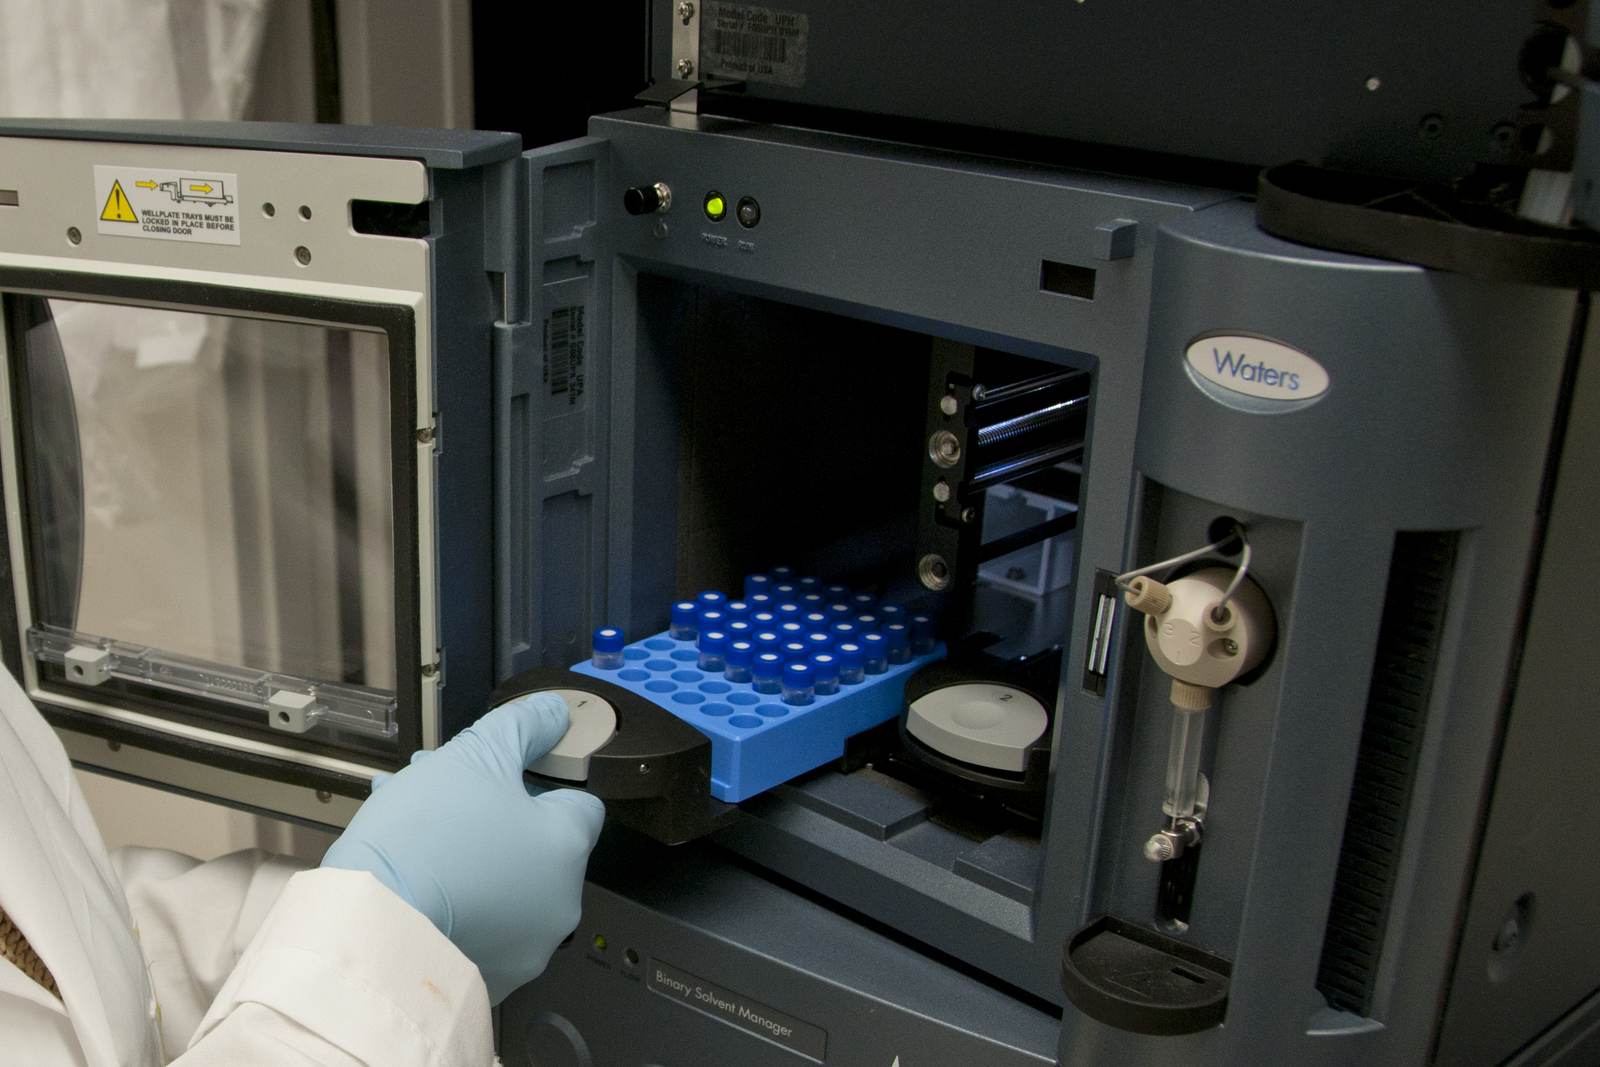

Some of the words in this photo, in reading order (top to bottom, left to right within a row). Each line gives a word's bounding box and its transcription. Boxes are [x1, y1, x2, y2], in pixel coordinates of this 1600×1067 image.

[746, 10, 768, 24] Code
[142, 210, 180, 219] WELLPLATE
[182, 212, 203, 220] TRAYS
[204, 214, 223, 222] MUST
[224, 215, 234, 223] BE
[141, 218, 170, 226] LOCKED
[181, 221, 204, 229] PLACE
[206, 222, 235, 231] BEFORE
[142, 225, 171, 234] CLOSING
[172, 227, 192, 235] DOOR
[1213, 347, 1300, 391] Waters
[1000, 694, 1013, 702] 2
[655, 970, 692, 995] Binary
[695, 987, 736, 1014] Solvent
[738, 1005, 793, 1038] Manager
